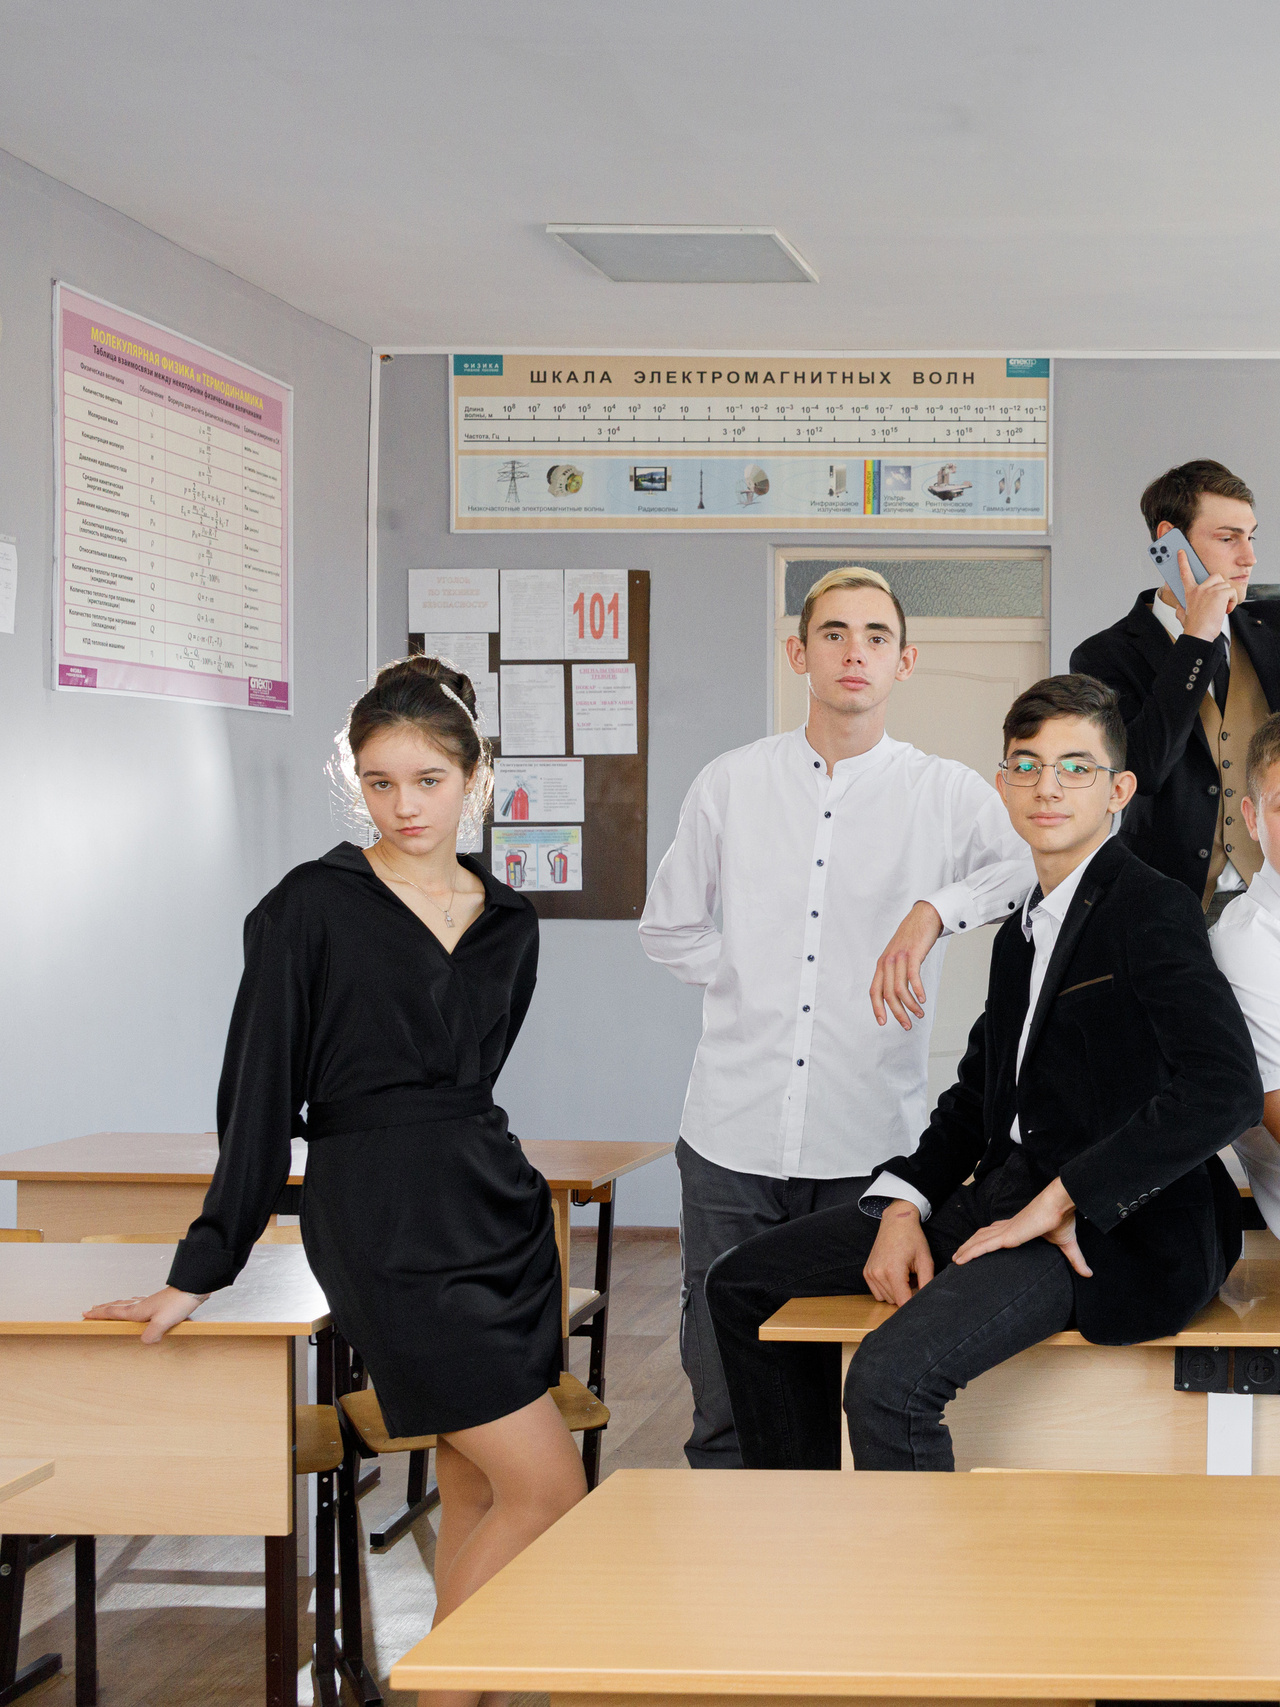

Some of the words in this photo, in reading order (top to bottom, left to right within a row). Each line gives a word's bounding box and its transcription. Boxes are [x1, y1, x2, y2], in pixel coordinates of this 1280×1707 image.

[80, 362, 105, 376] Физическая
[91, 326, 160, 367] МОЛЕКУЛЯРНАЯ
[161, 356, 195, 381] ФИЗИКА
[202, 373, 264, 410] ТЕРМОДИНАМИКА
[93, 344, 117, 362] Таблица
[118, 357, 153, 376] взаимосвязи
[154, 371, 172, 385] между
[172, 378, 204, 396] некоторыми
[204, 390, 234, 409] физическими
[235, 404, 262, 420] величинами
[530, 370, 613, 384] ШКАЛА
[634, 370, 891, 385] ЭЛЕКТРОМАГНИТНЫХ
[913, 371, 974, 385] ВОЛН
[521, 505, 583, 513] электромагнитные
[637, 505, 678, 513] Радиоволны
[437, 576, 471, 584] УГОЛОК
[573, 592, 619, 640] 101
